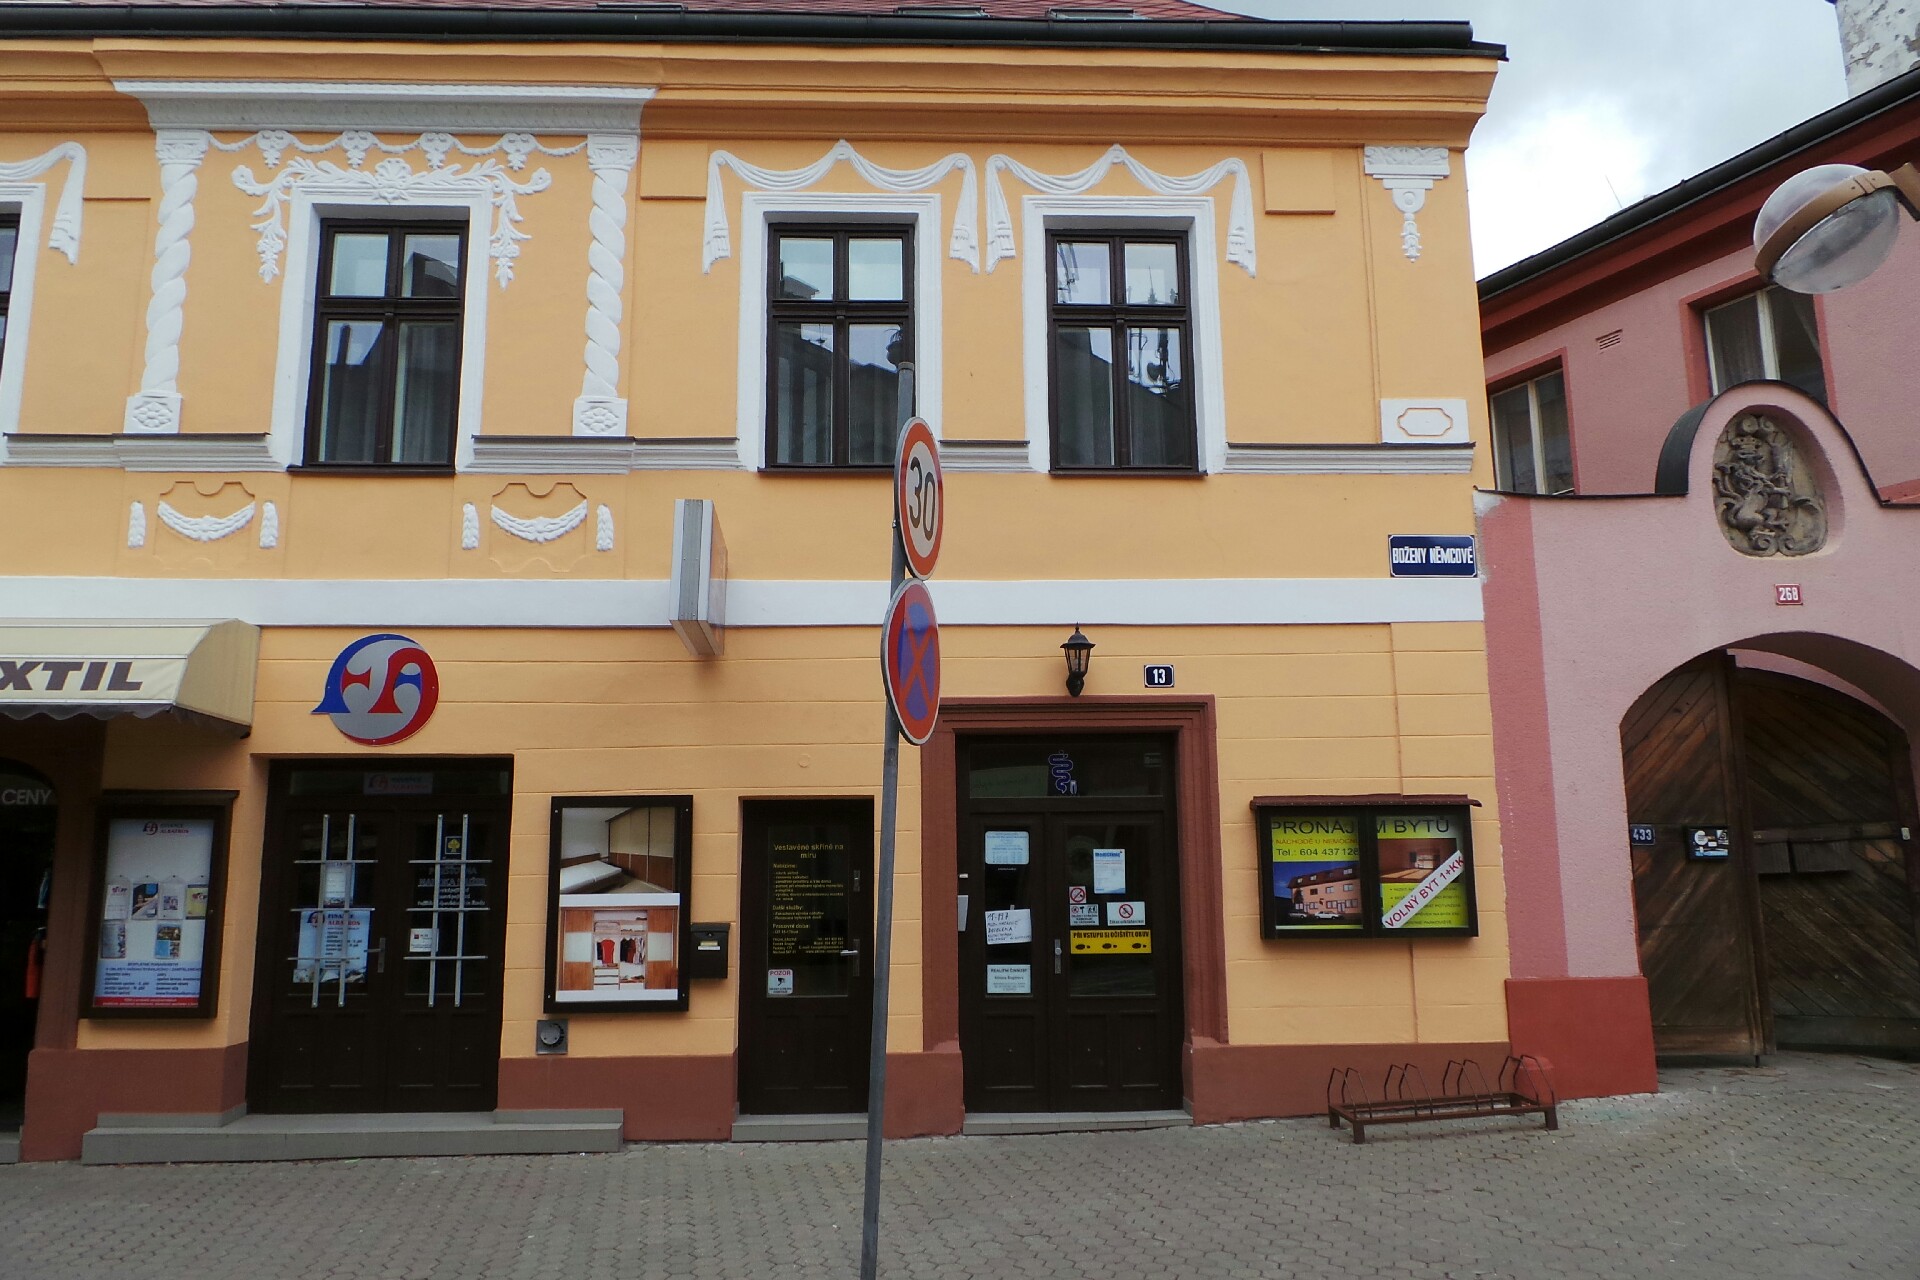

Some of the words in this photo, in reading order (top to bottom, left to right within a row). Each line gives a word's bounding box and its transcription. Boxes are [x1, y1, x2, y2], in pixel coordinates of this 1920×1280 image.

[908, 456, 936, 542] 30
[1392, 546, 1427, 564] BOŽENY
[1429, 545, 1474, 564] NĚMCOVÉ
[1778, 587, 1799, 601] 268
[1153, 668, 1166, 684] 13
[1, 788, 53, 806] CENY
[1632, 828, 1653, 841] 433
[1299, 848, 1319, 856] 604
[1321, 848, 1340, 856] 437
[1419, 878, 1440, 899] BYT
[1439, 855, 1465, 880] 1+KK
[1073, 931, 1083, 939] PŘI
[1134, 930, 1150, 938] OBUV
